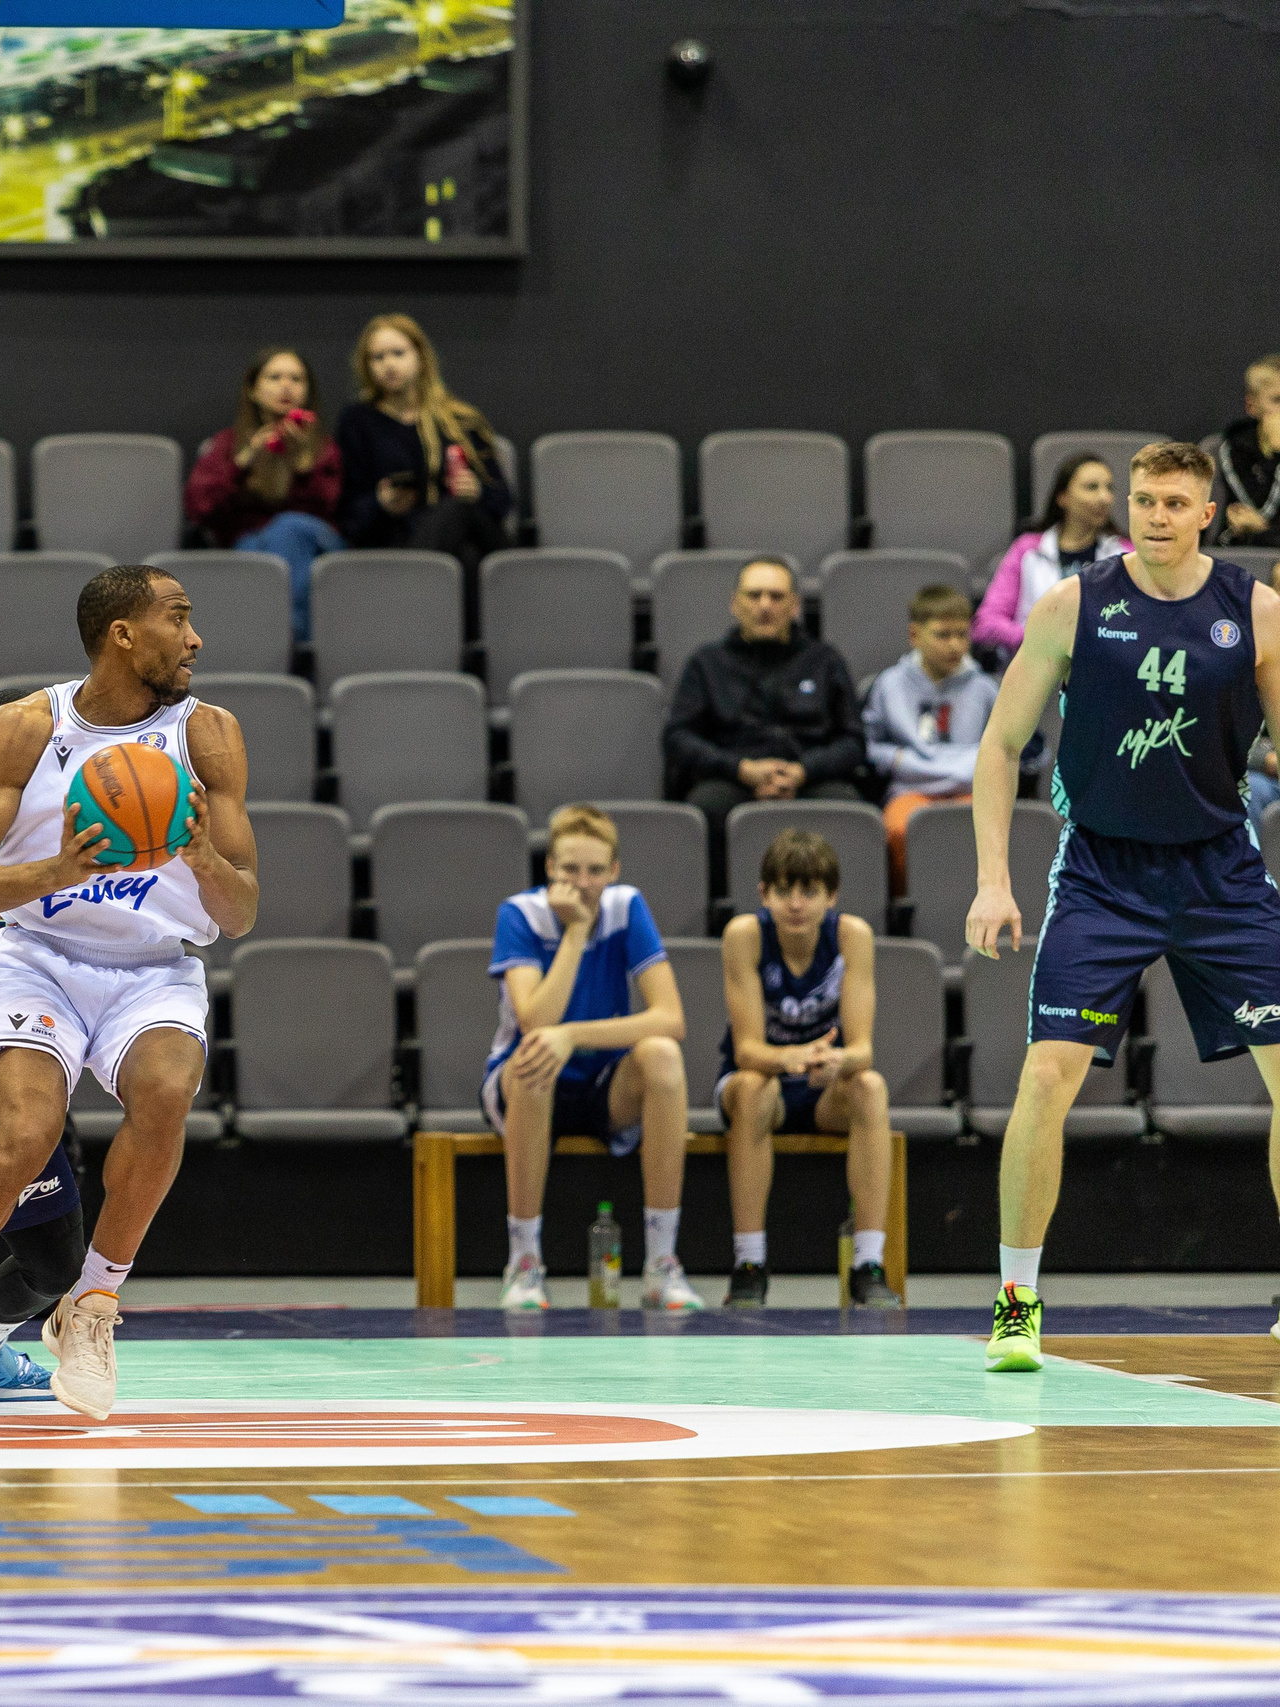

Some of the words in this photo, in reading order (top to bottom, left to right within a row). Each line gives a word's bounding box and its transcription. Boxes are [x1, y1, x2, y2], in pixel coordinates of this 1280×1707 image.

[1098, 627, 1138, 642] Kempa
[1137, 646, 1187, 695] 44
[1039, 1004, 1077, 1018] Kempa
